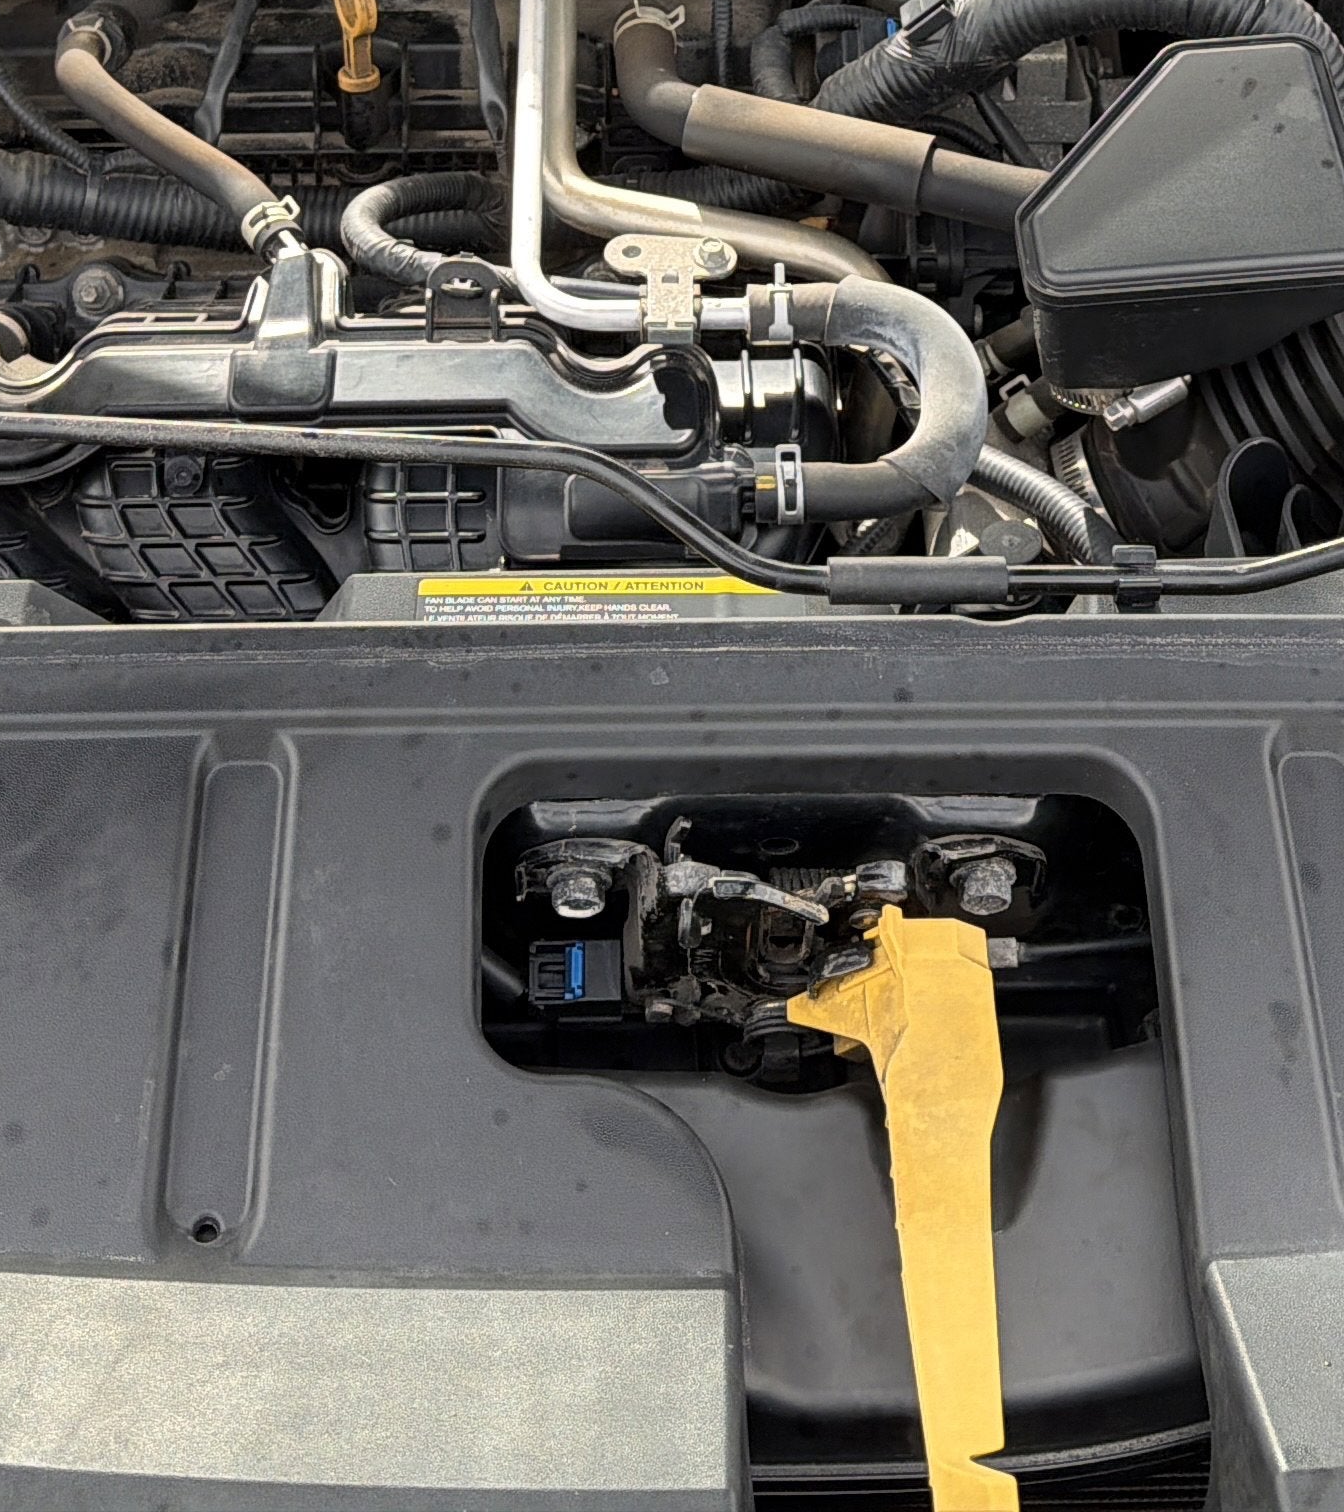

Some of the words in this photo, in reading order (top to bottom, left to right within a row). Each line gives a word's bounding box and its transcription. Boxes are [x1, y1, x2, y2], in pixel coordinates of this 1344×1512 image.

[543, 581, 609, 591] CAUTION
[613, 581, 621, 591] /
[624, 581, 705, 591] ATTENTION
[499, 596, 528, 604] START
[424, 605, 437, 613] TO
[439, 605, 464, 613] HELP
[495, 604, 545, 612] PERSONAL
